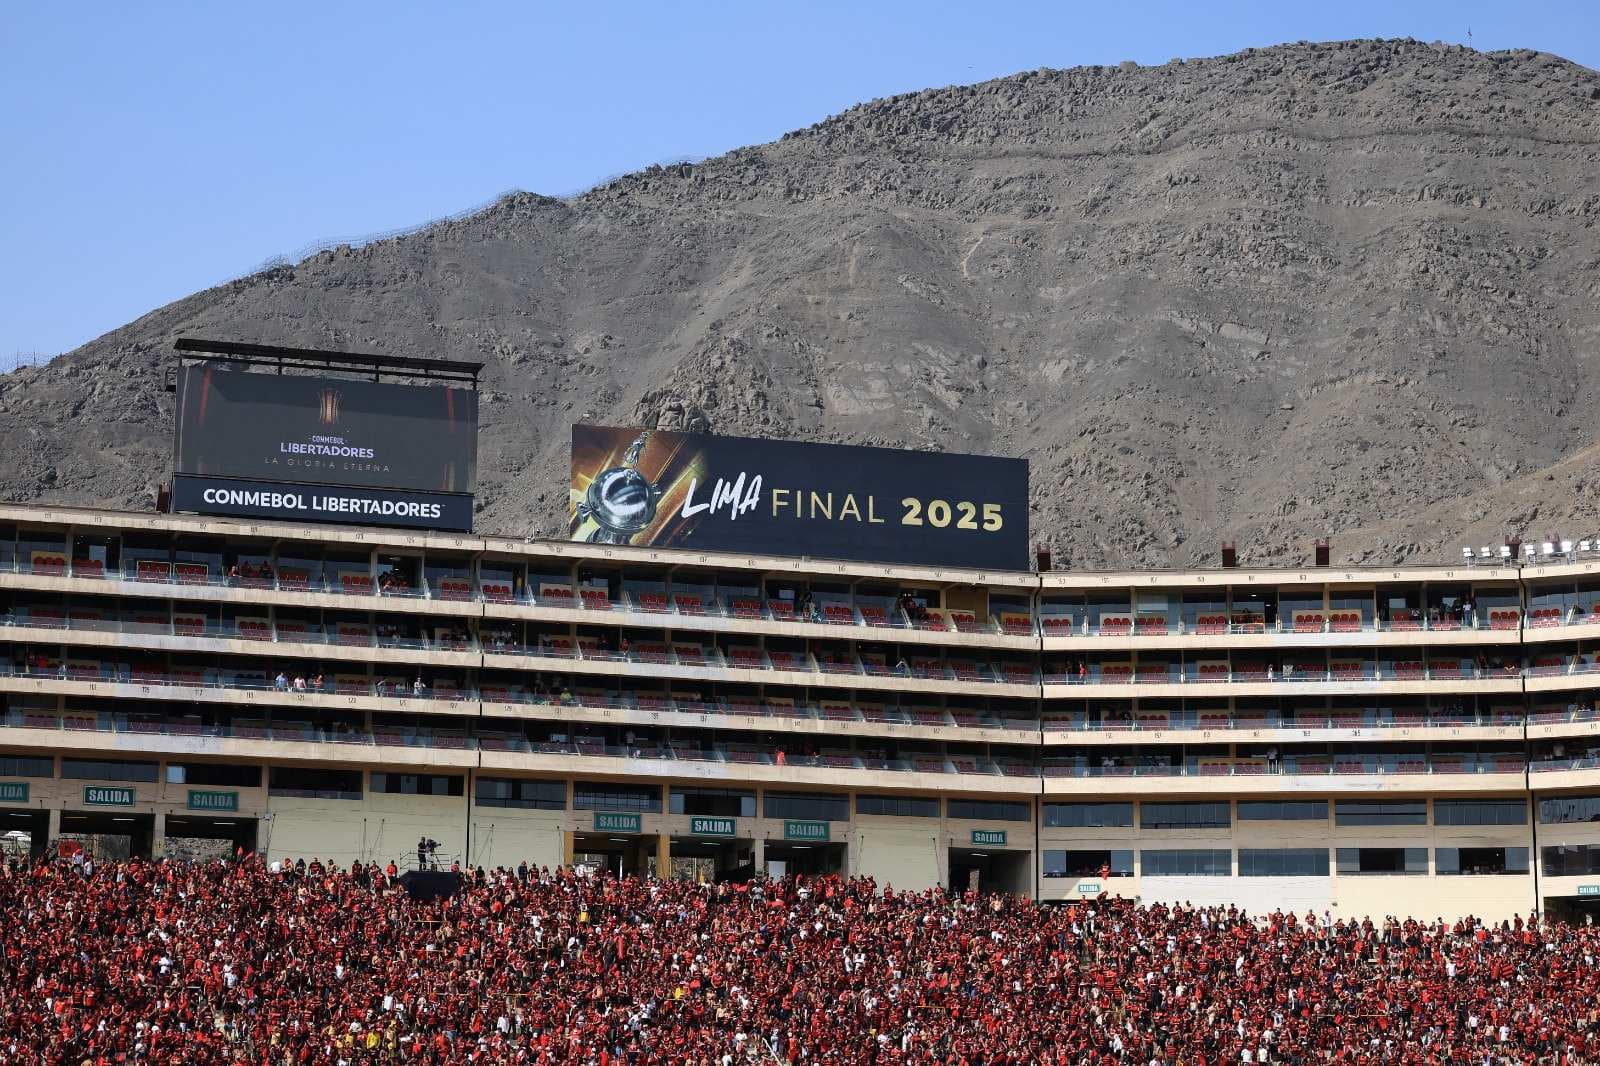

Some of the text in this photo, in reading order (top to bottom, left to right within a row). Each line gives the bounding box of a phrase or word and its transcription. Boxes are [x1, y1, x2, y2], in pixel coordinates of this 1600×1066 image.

[312, 435, 345, 445] CONMEBOL
[280, 442, 375, 459] LIBERTADORES
[265, 457, 279, 465] LA
[203, 488, 442, 518] CONMEBOL LIBERTADORES
[682, 472, 1004, 532] LIMA FINAL 2025
[88, 789, 130, 804] SALIDA
[192, 793, 234, 808] SALIDA
[599, 816, 637, 829] SALIDA
[694, 820, 732, 834] SALIDA
[788, 825, 825, 837] SALIDA
[974, 832, 1004, 843] SALIDA
